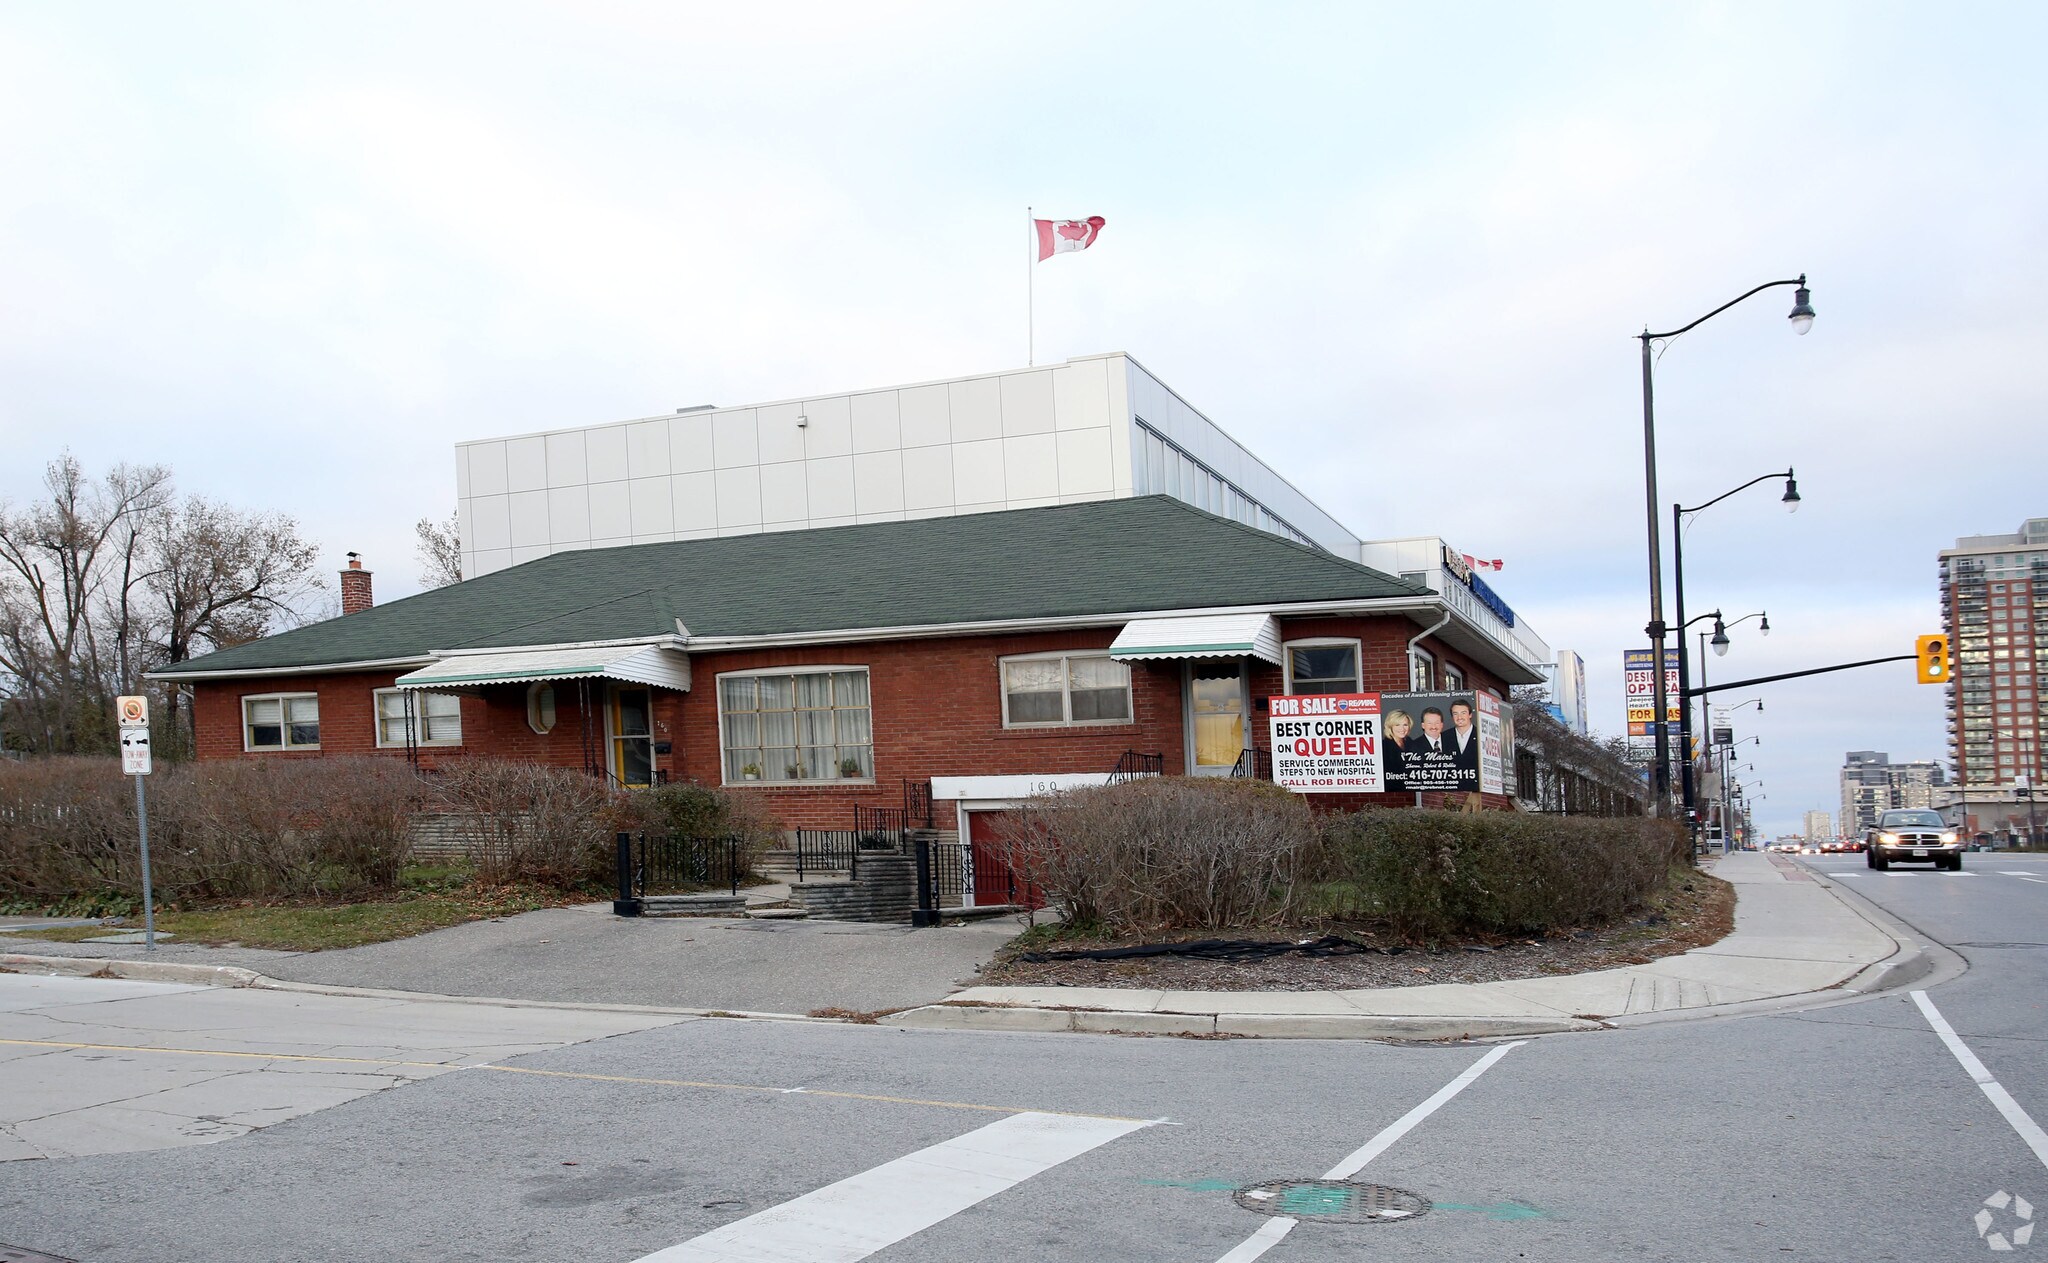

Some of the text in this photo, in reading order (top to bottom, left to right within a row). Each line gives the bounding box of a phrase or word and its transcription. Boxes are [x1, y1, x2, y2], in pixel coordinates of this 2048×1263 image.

[1271, 697, 1337, 715] FOR SALE
[1348, 699, 1377, 707] RE/MAX
[1630, 710, 1651, 719] FOR
[1276, 720, 1373, 737] BEST CORNER
[1277, 737, 1375, 757] ON QUEEN
[130, 760, 144, 769] ZONE
[1279, 758, 1375, 768] SERVICE COMMERCIAL
[1280, 767, 1375, 776] STEPS TO NEW HOSPITAL
[1385, 769, 1476, 780] Direct: 416-707-3115
[1030, 781, 1057, 791] 160
